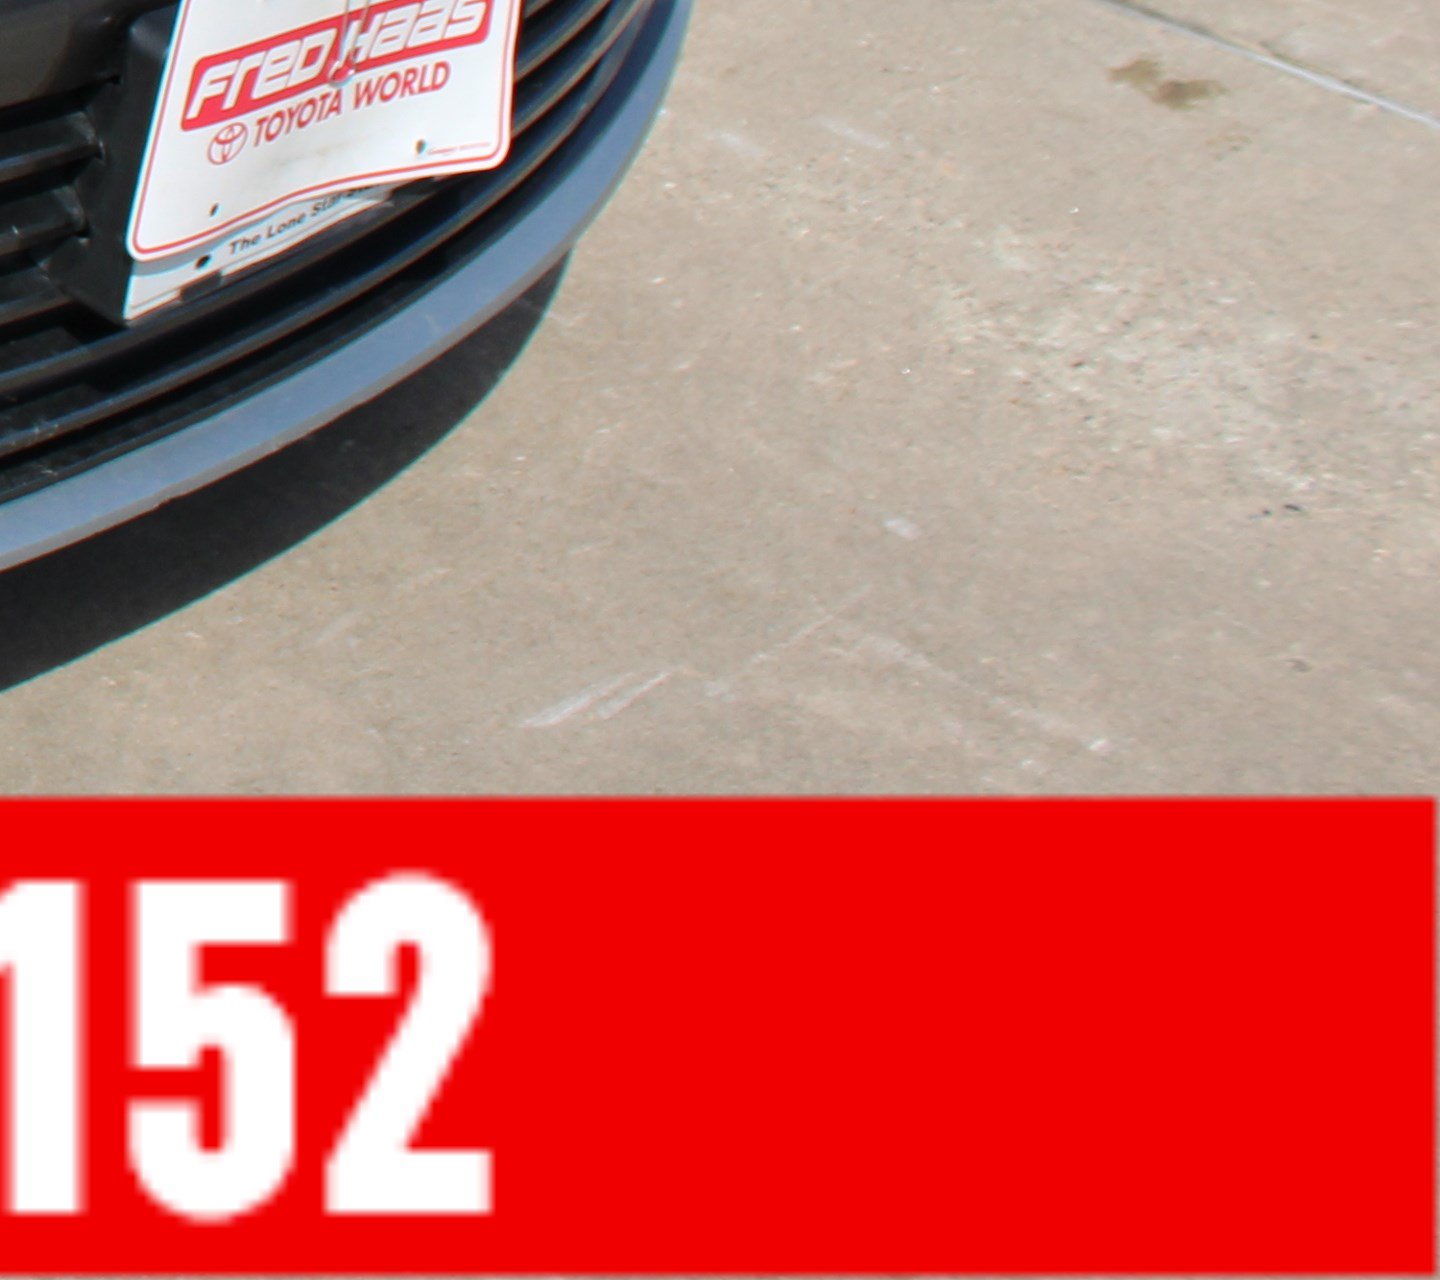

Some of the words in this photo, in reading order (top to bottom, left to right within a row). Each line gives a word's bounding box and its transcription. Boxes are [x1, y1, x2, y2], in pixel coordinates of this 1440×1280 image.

[253, 91, 342, 147] TOYOTA
[353, 60, 451, 111] WORLD
[229, 233, 263, 255] The
[266, 210, 307, 239] Lone
